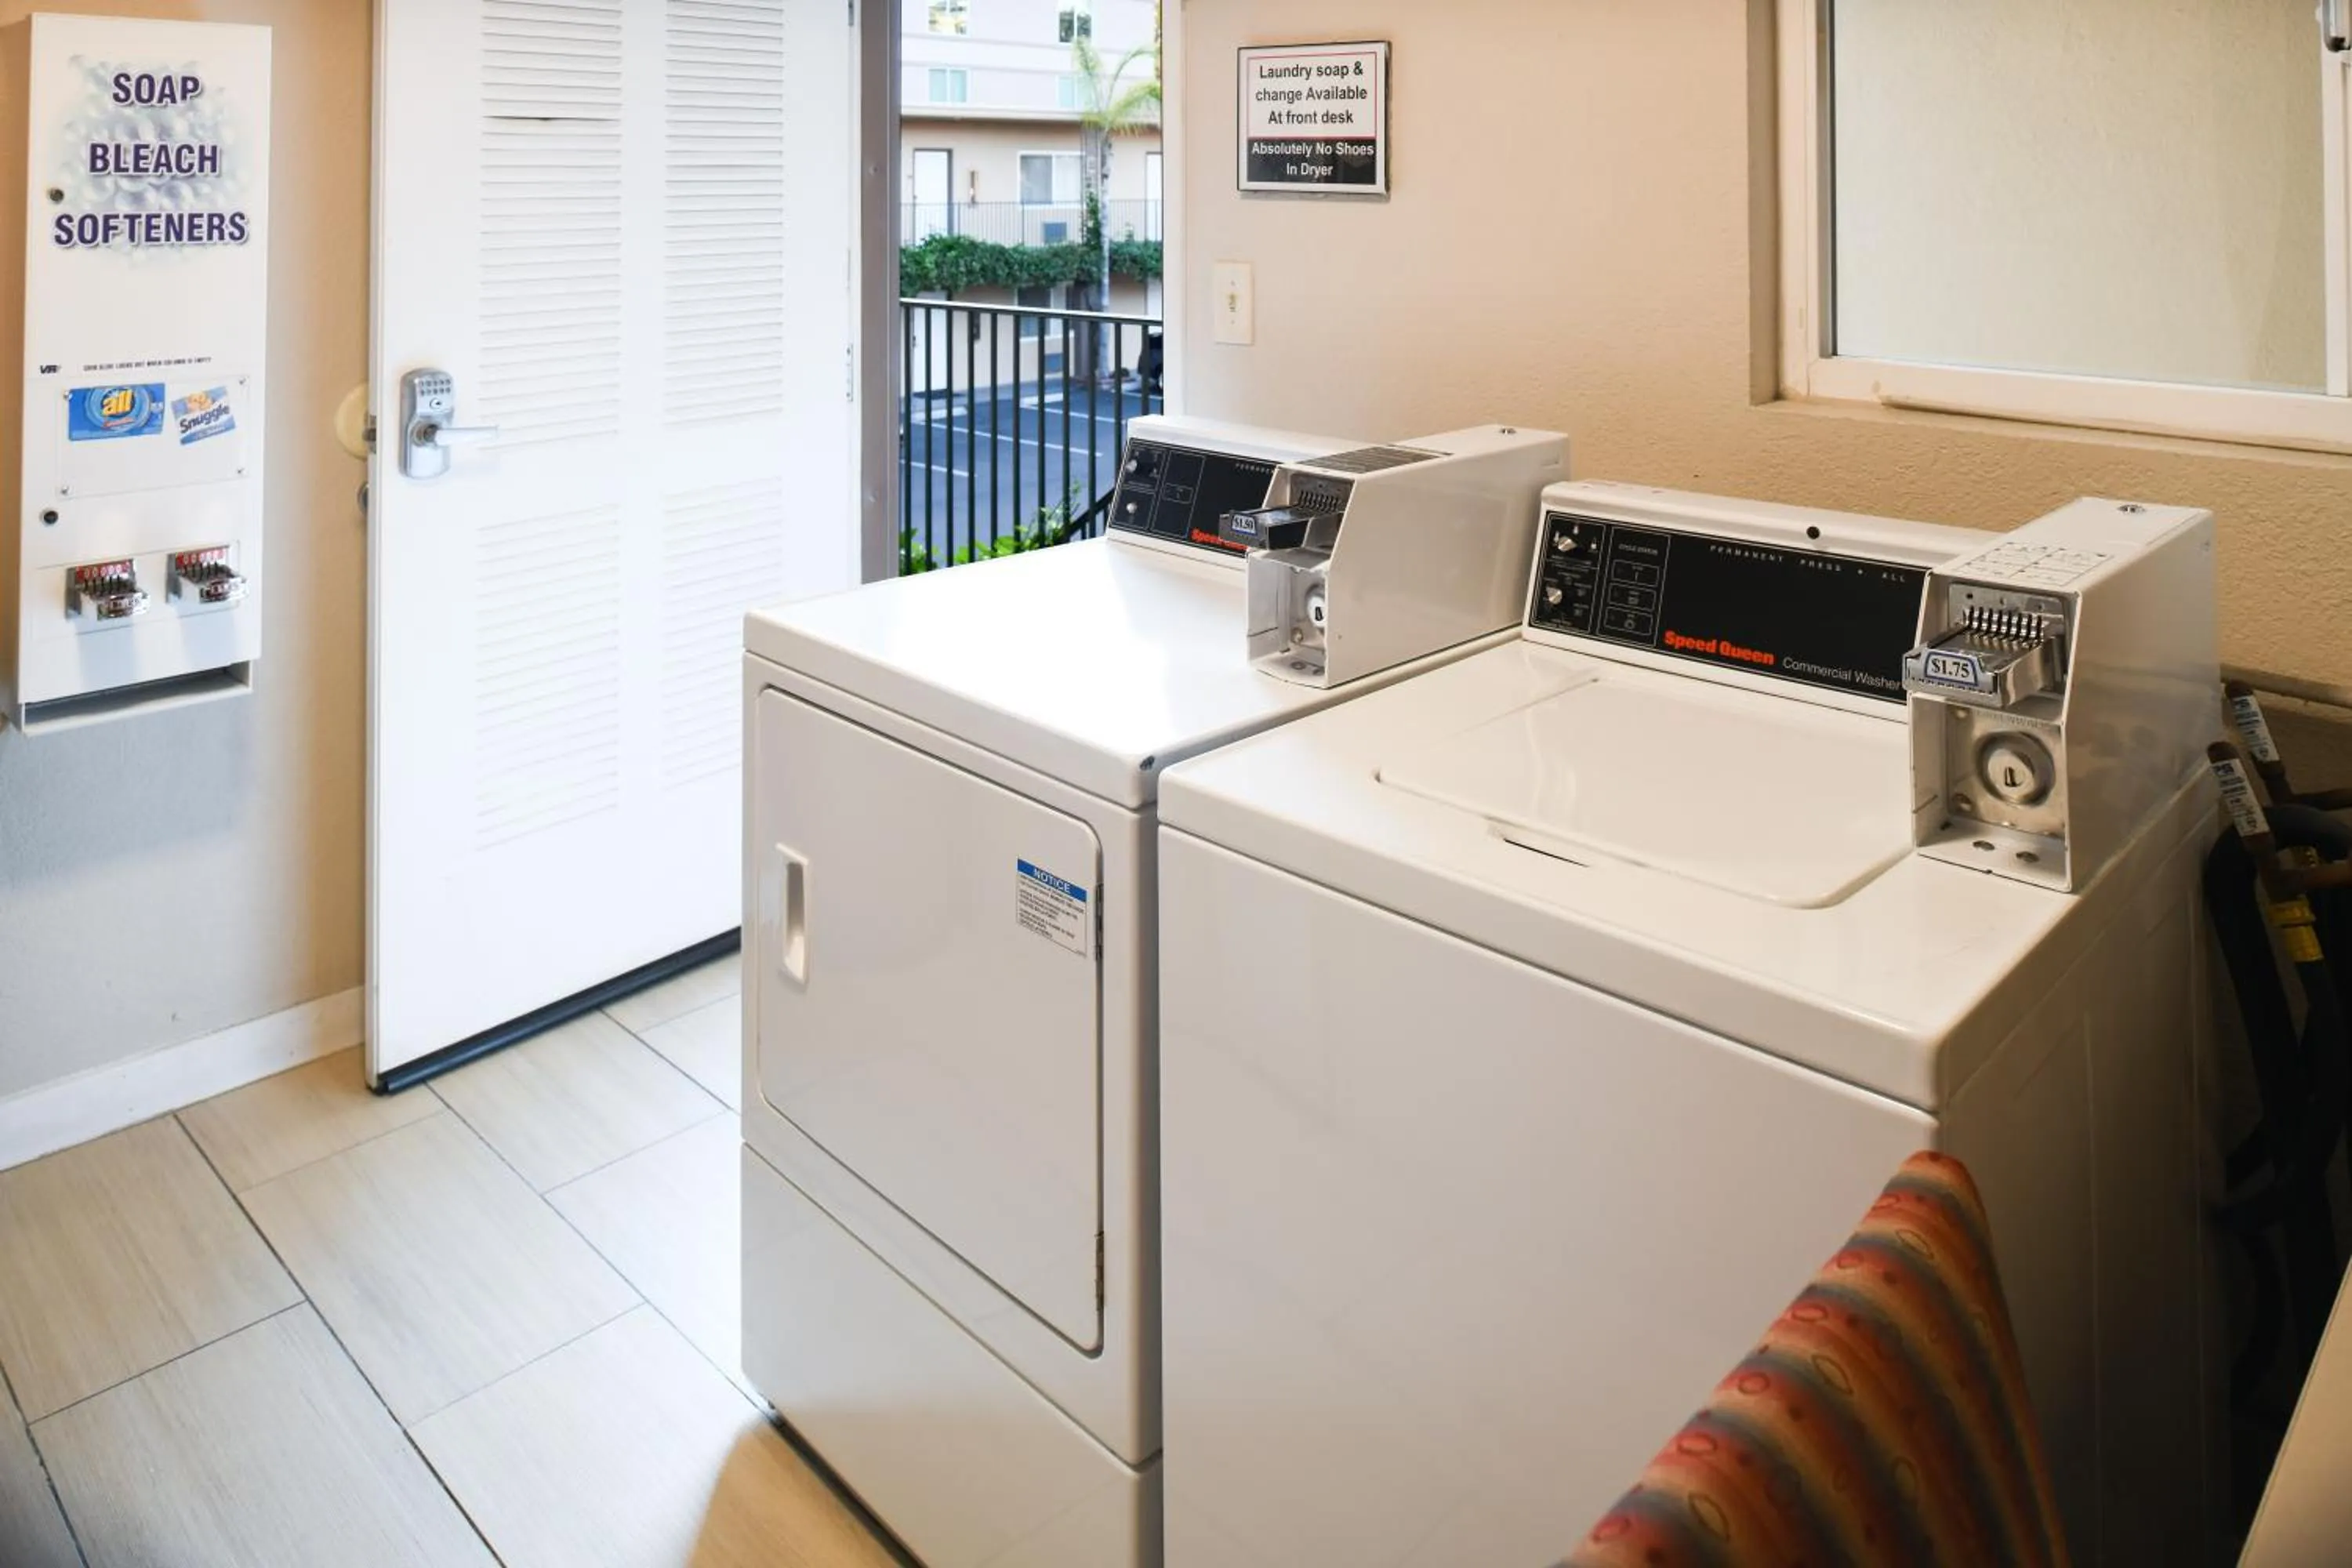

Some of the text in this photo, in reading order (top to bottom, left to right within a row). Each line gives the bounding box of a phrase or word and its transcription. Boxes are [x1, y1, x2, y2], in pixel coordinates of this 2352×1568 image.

[1259, 60, 1363, 80] Laundry soap &
[112, 72, 201, 104] SOAP
[1255, 85, 1368, 104] change Available
[1268, 109, 1354, 125] At front desk
[89, 143, 219, 174] BLEACH
[1251, 141, 1374, 158] Absolutely No Shoes
[1286, 162, 1334, 179] In Dryer
[54, 212, 247, 245] SOFTENERS
[102, 388, 133, 416] all
[180, 400, 230, 434] Snuggle
[1664, 630, 1902, 691] Speed Queen Commercial Washer
[1930, 658, 1970, 678] $1.75
[1034, 868, 1071, 891] NOTICE
